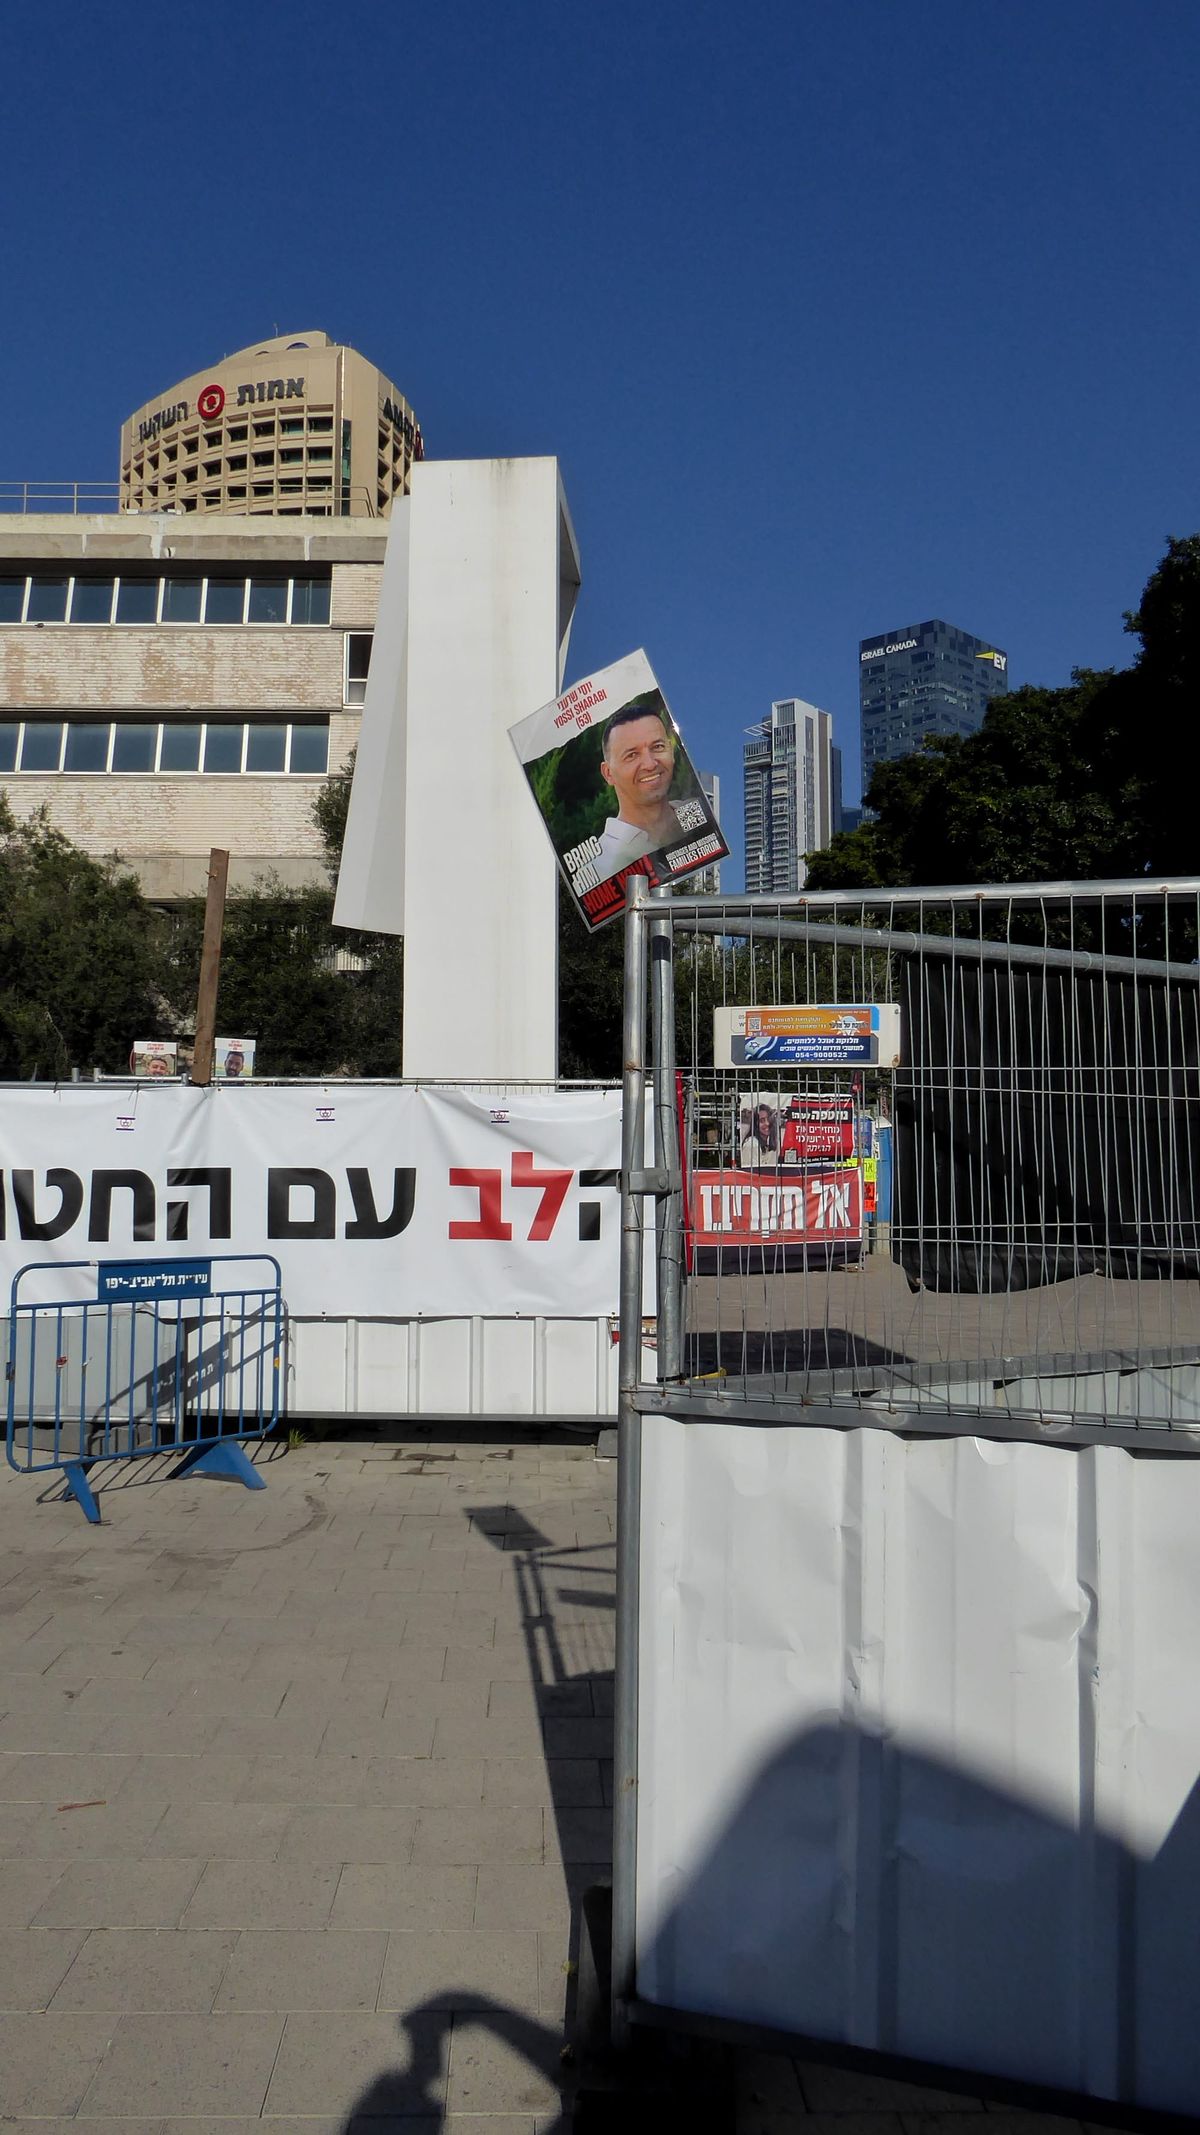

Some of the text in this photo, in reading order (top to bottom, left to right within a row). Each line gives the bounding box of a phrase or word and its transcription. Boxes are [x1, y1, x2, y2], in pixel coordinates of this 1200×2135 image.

[237, 377, 305, 407] אמות
[861, 639, 917, 661] ISRAEL CANADA
[994, 653, 1006, 670] EY
[553, 689, 607, 729] YOSSI SHARABI
[575, 711, 593, 730] (53)
[563, 835, 603, 874] BRING
[669, 839, 722, 871] FAMILIES FORUM
[583, 878, 621, 916] HOME
[835, 1037, 859, 1045] חלוקת
[0, 1152, 621, 1243] הלב עם החט
[811, 1179, 852, 1229] אל
